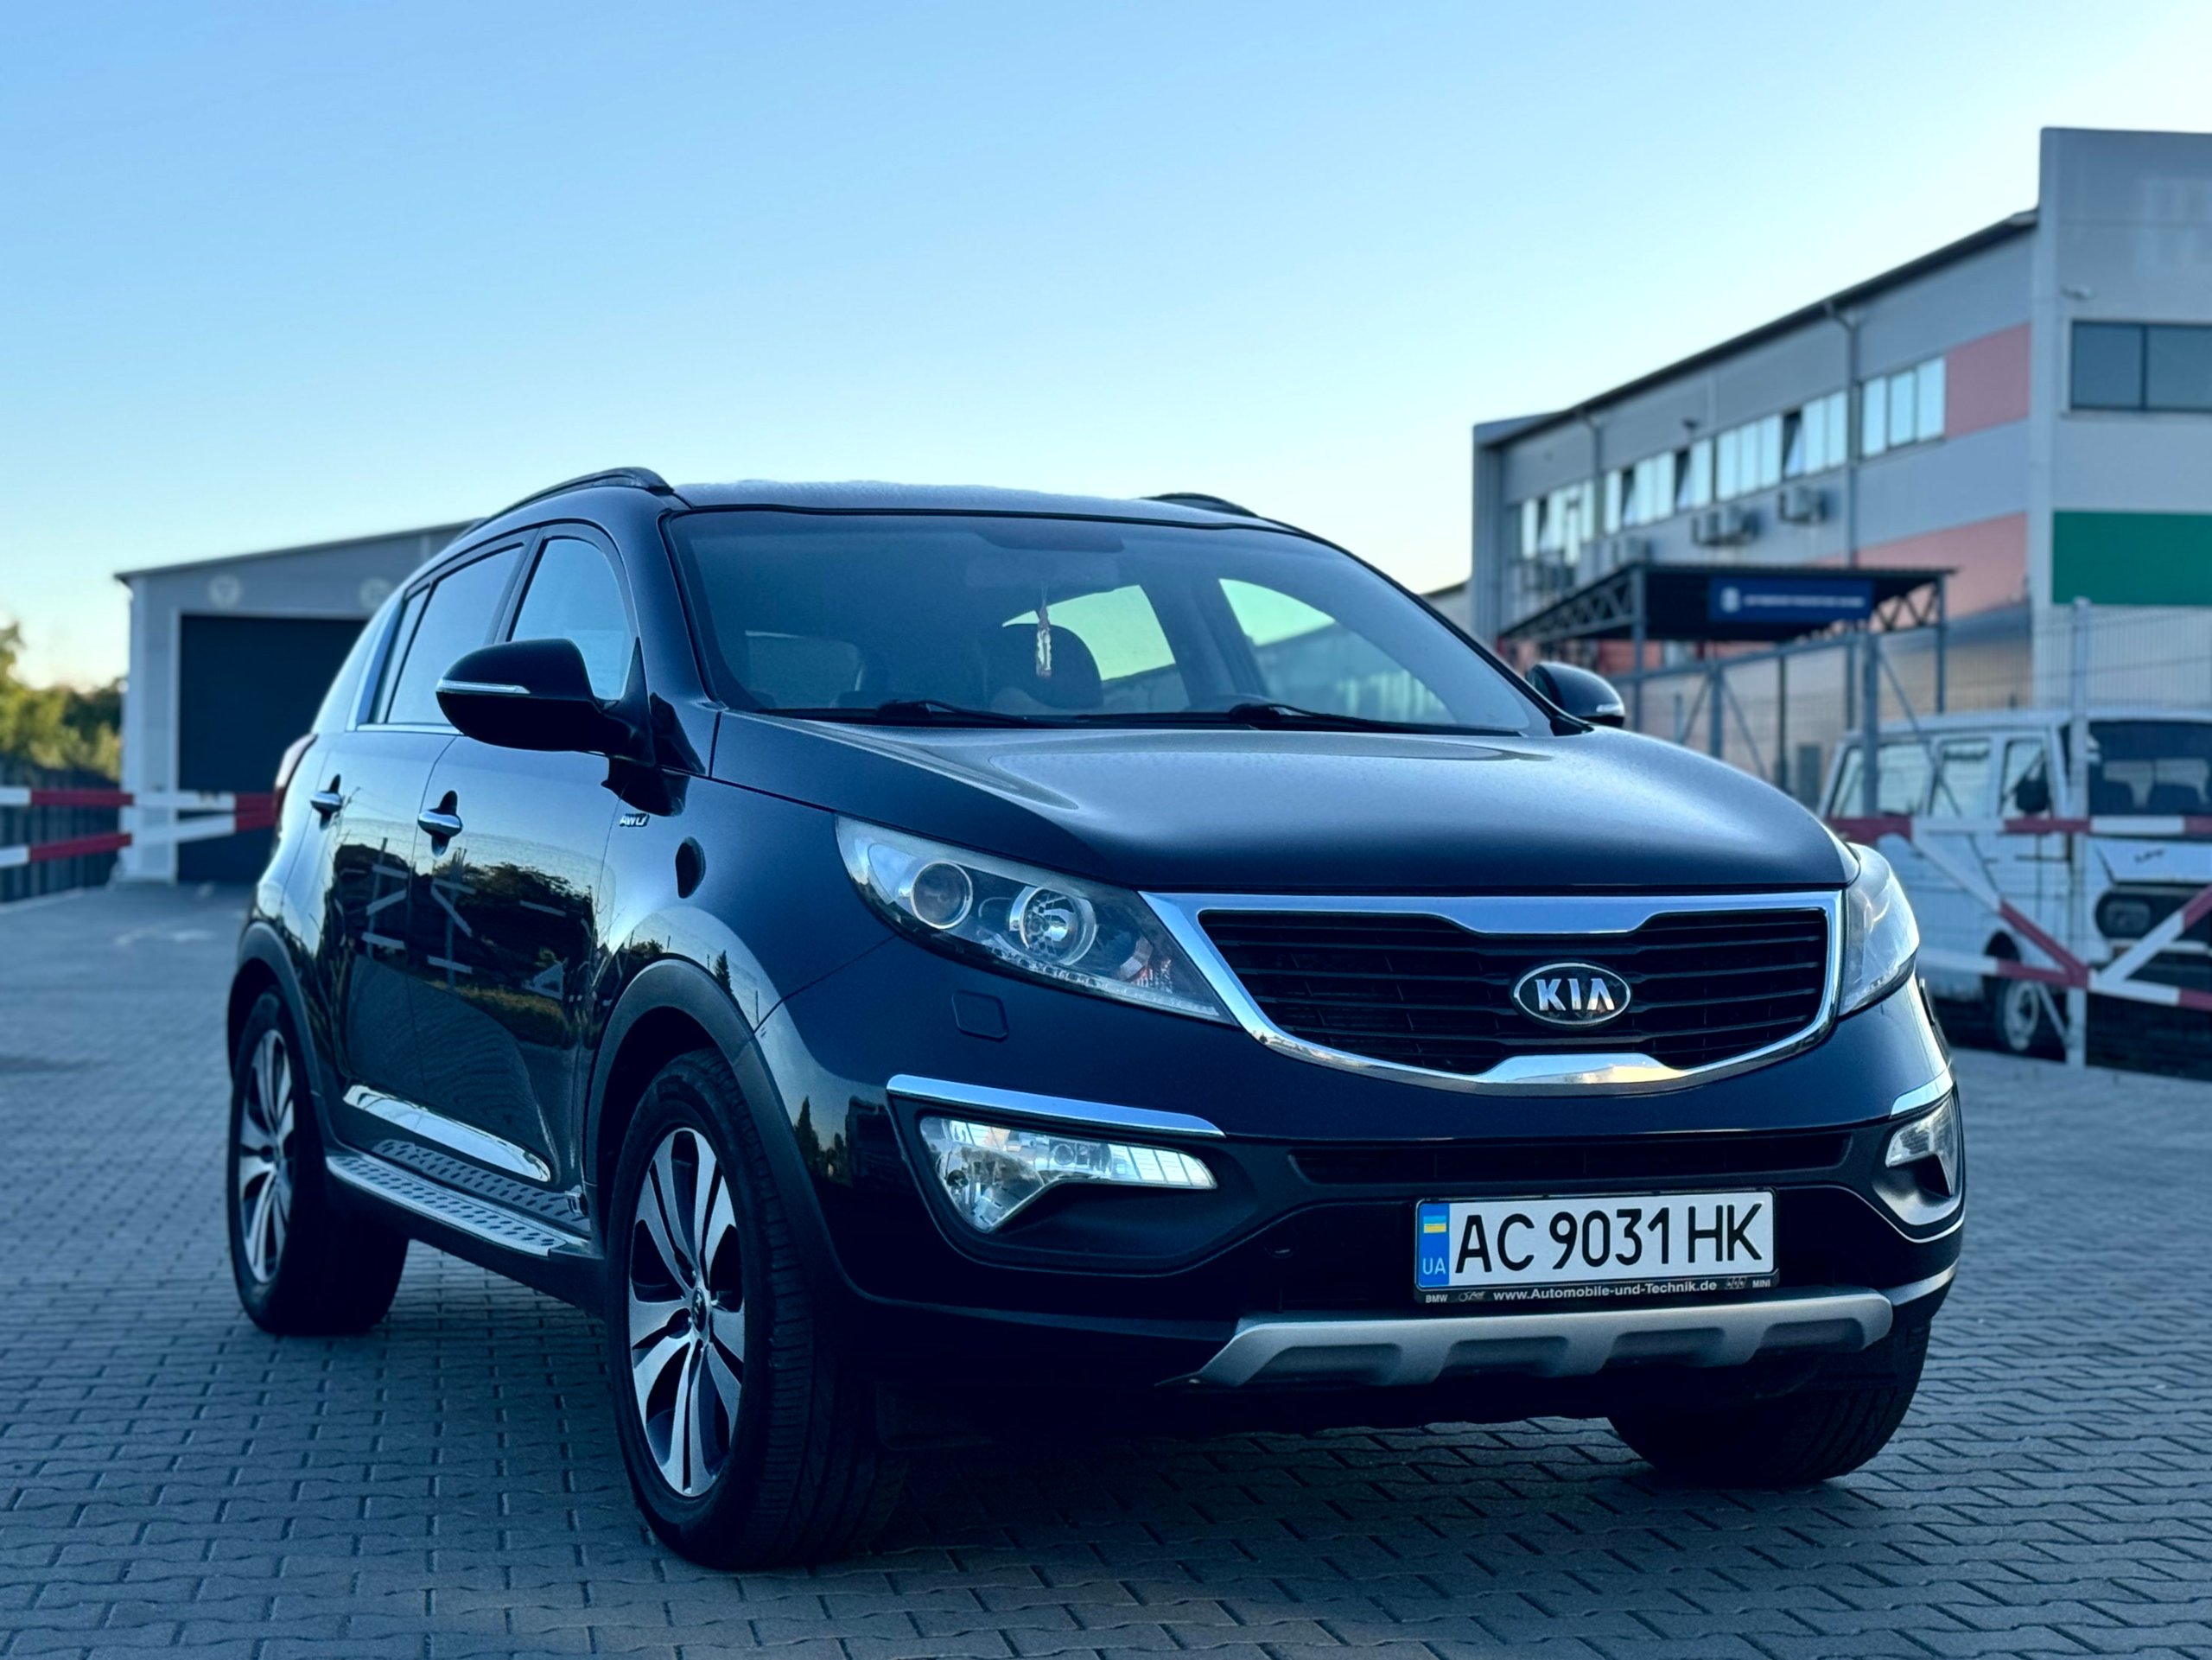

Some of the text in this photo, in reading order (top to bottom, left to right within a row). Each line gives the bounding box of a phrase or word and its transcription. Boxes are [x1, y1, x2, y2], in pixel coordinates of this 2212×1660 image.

[1535, 978, 1615, 1011] KIA
[1455, 1203, 1763, 1274] AC 9031 HK
[1422, 1256, 1446, 1275] UA
[1425, 1294, 1448, 1303] BMW
[1493, 1280, 1718, 1301] www.Automobile-und-Technik.de
